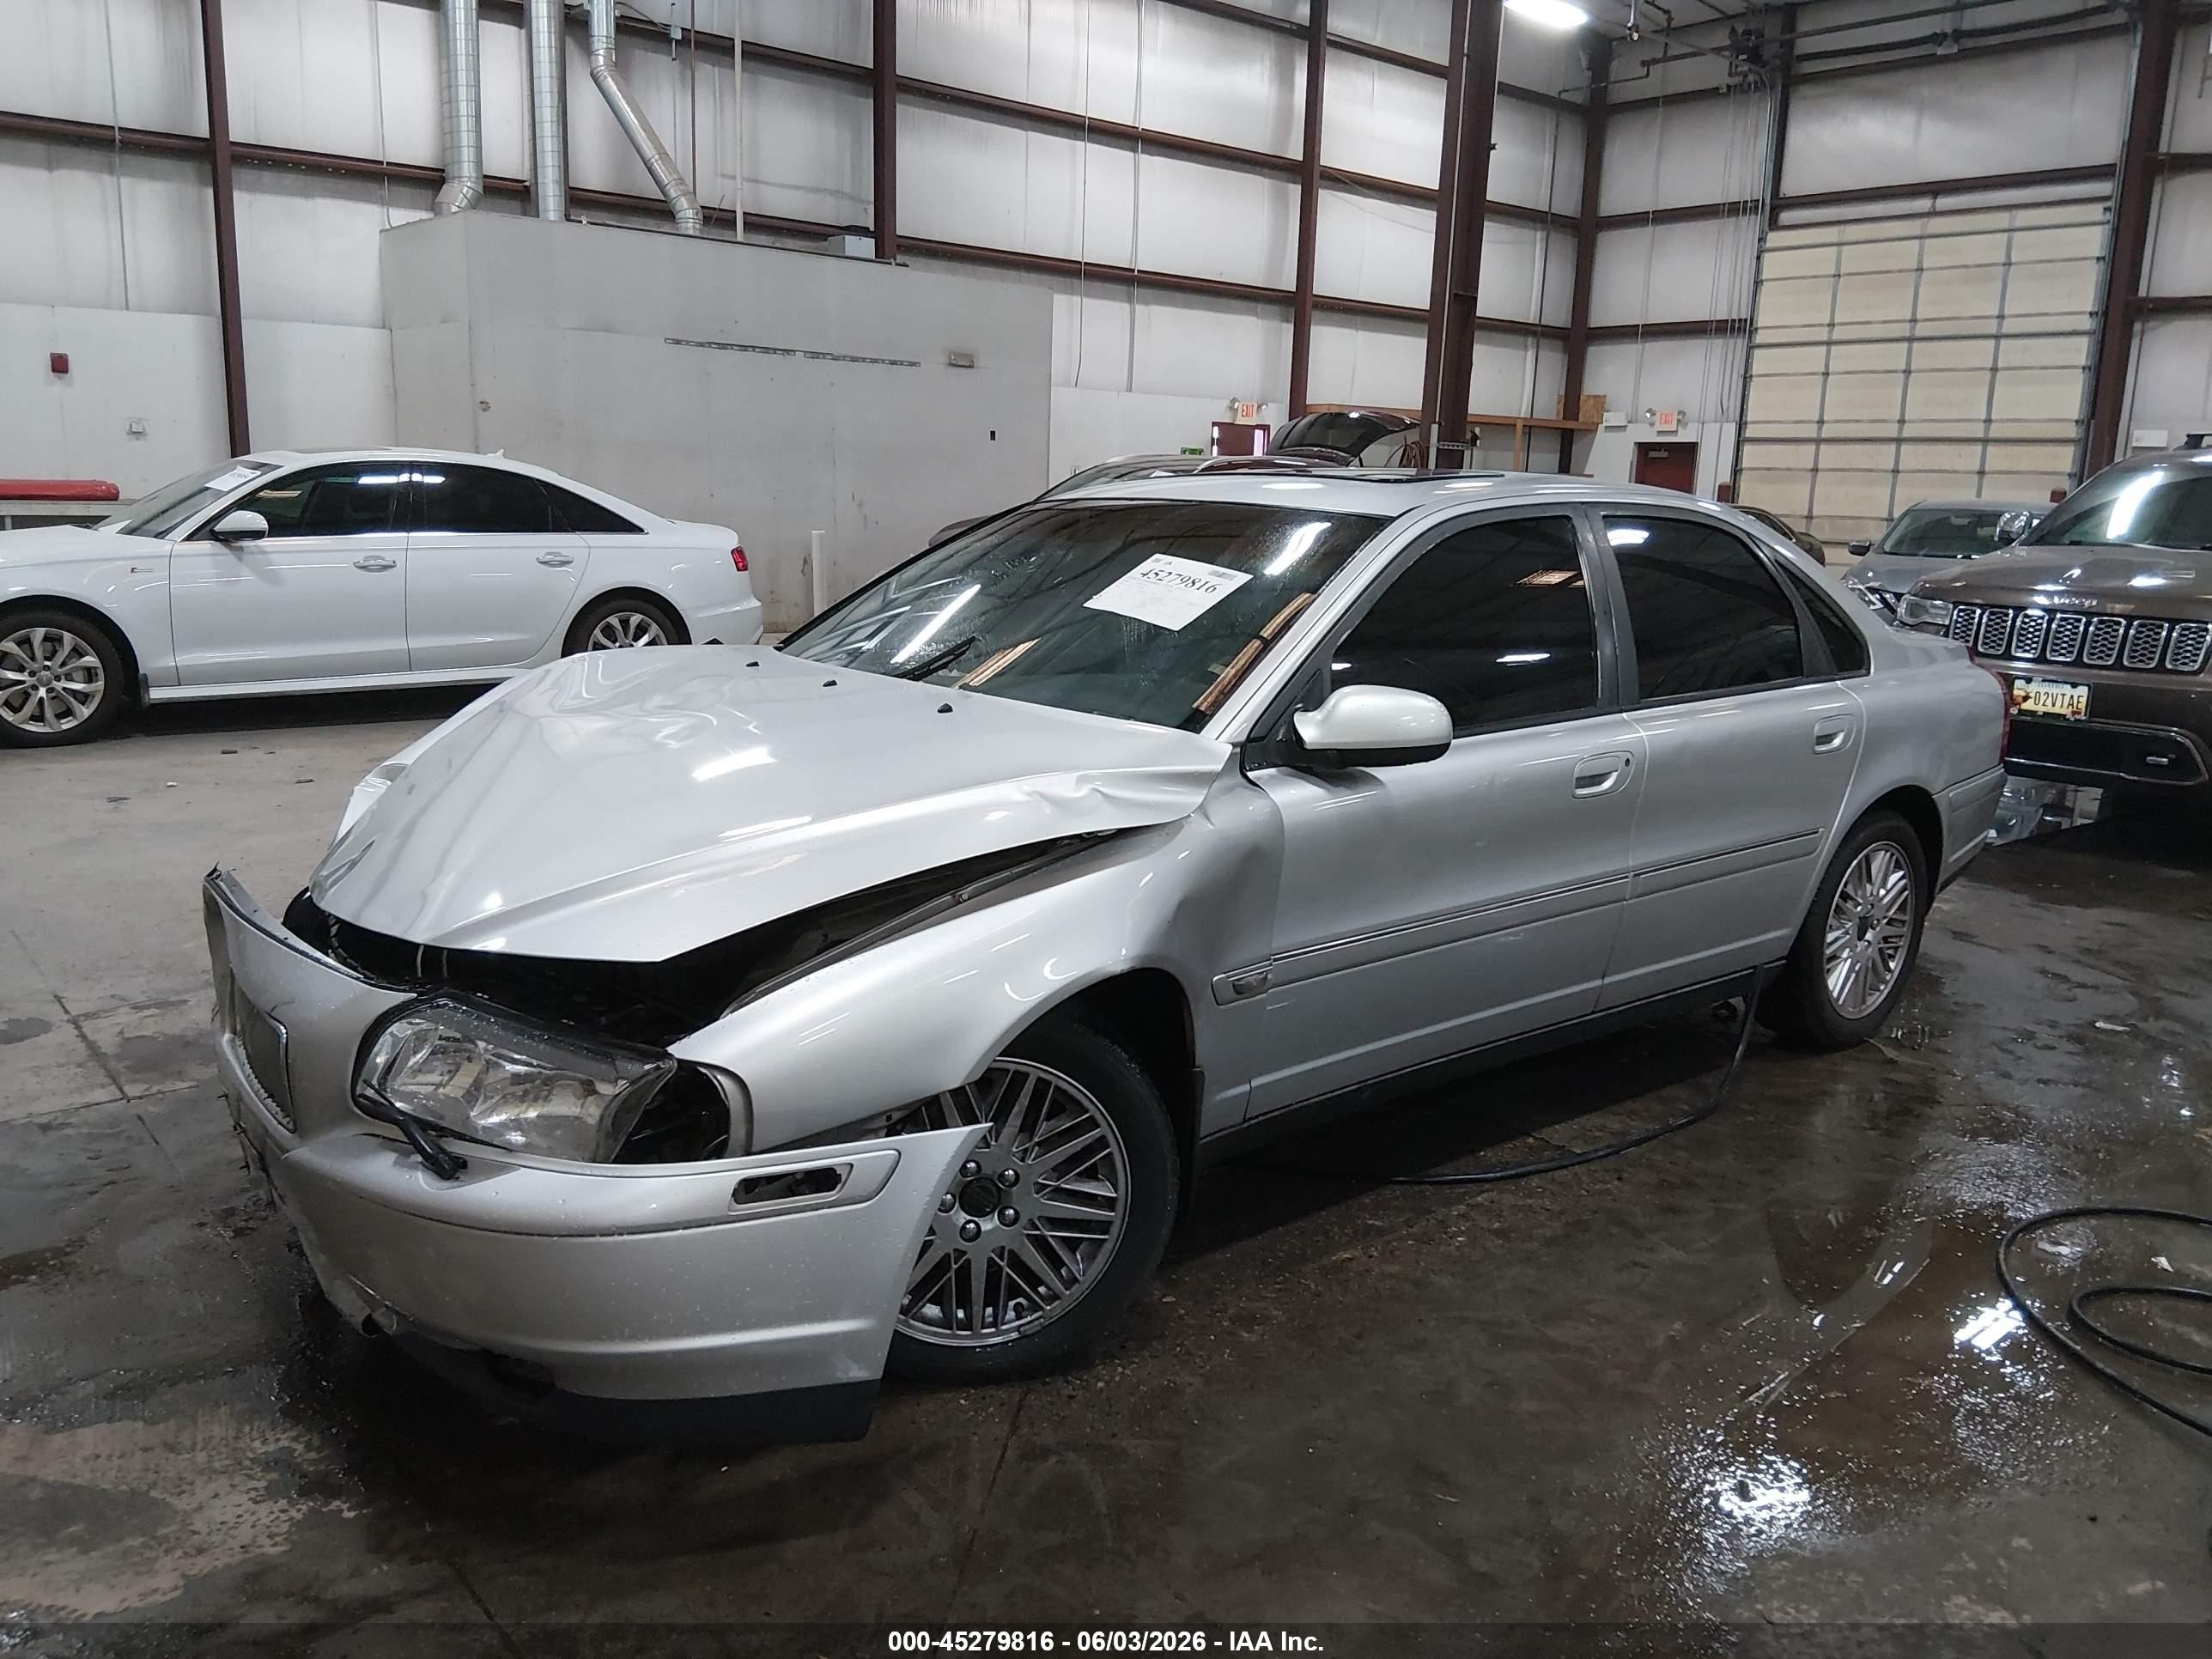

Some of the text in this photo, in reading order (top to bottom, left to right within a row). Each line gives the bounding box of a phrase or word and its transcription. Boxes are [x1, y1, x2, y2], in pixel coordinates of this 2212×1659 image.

[1241, 404, 1255, 418] EXIT
[1659, 412, 1674, 426] EXIT
[1140, 568, 1223, 593] 45279816
